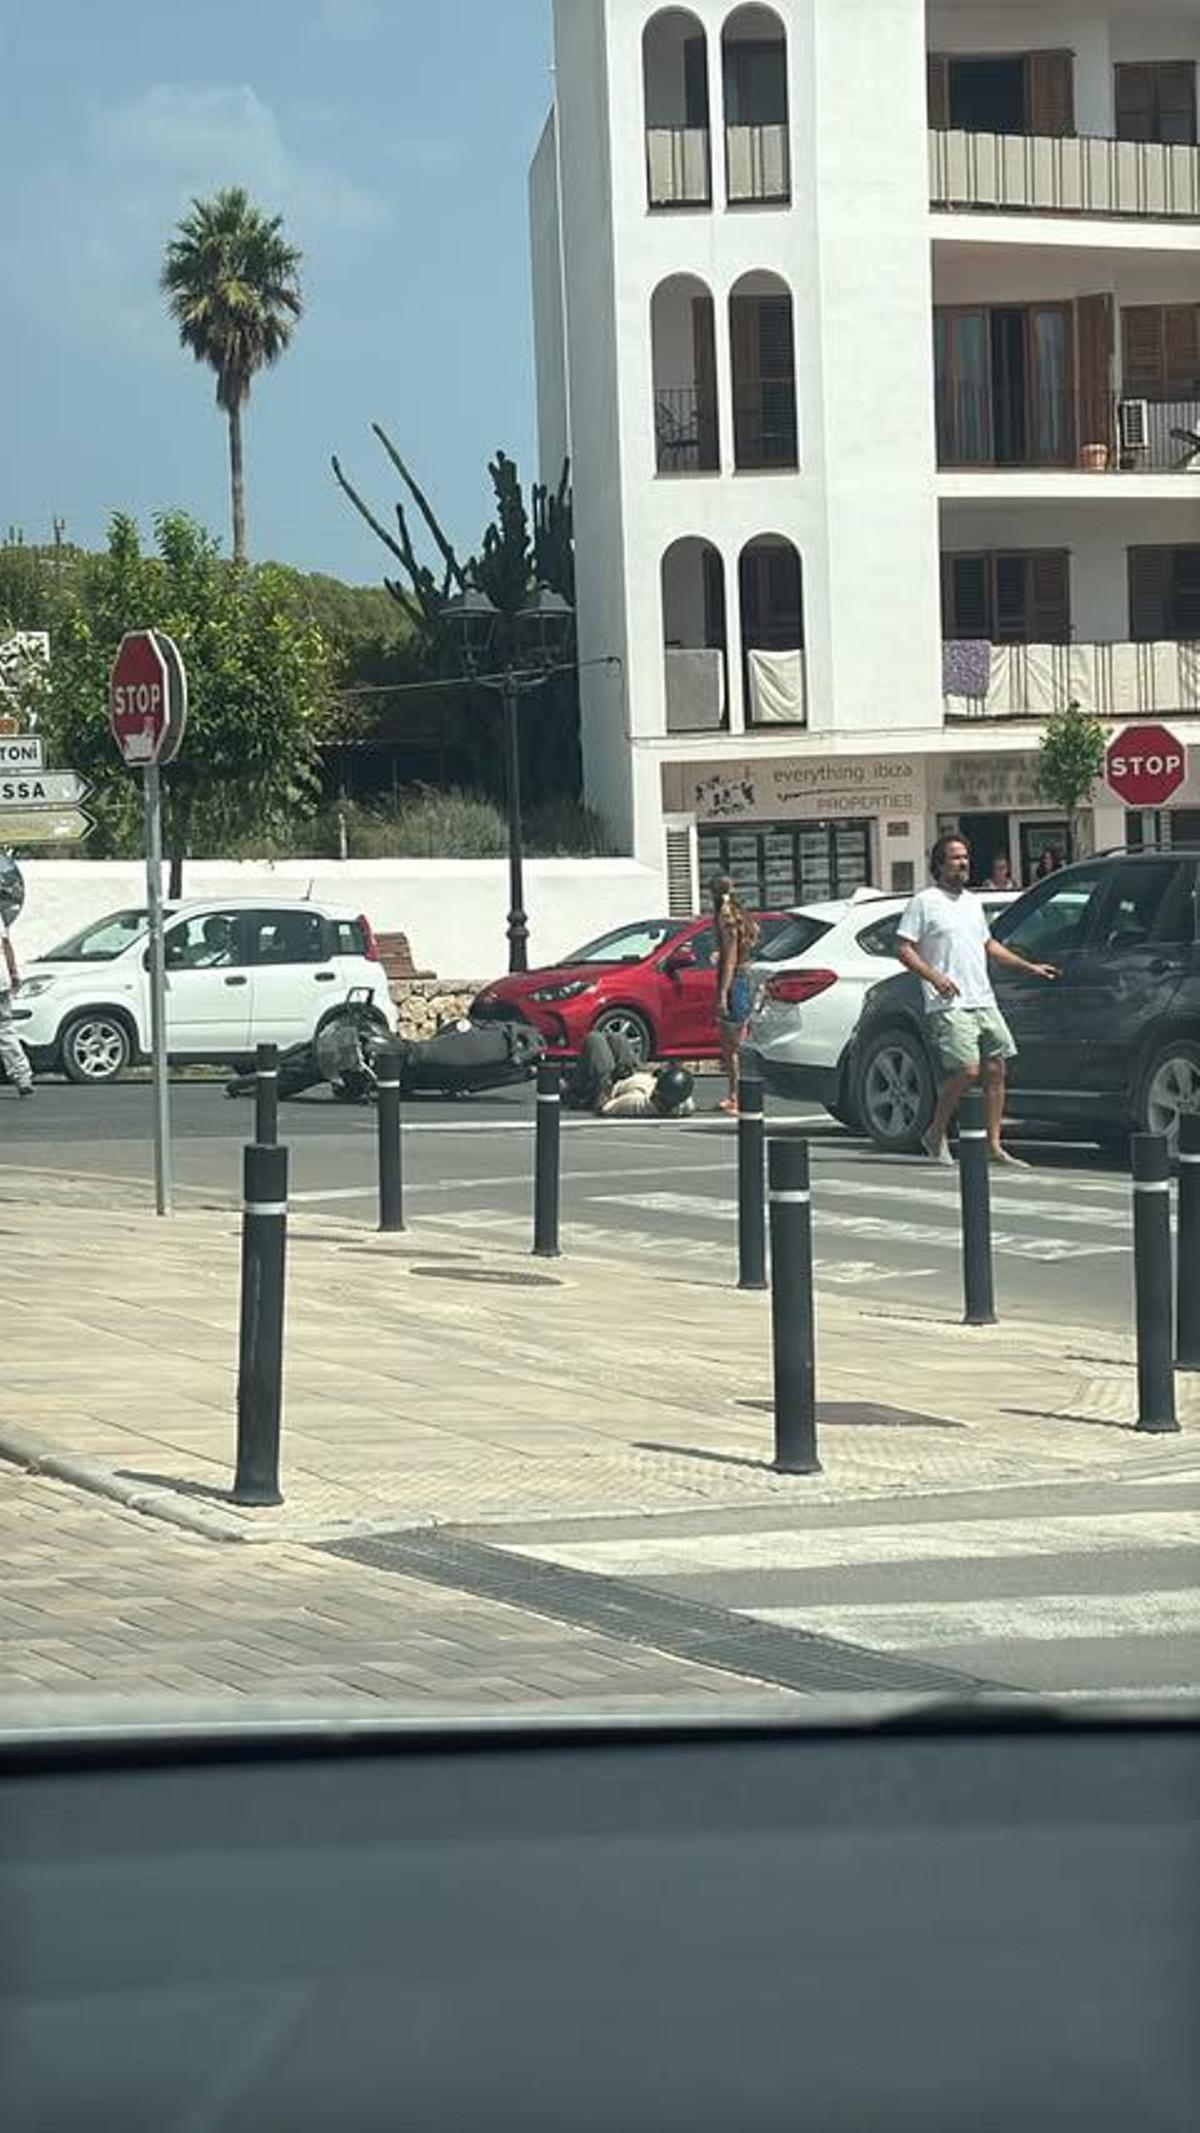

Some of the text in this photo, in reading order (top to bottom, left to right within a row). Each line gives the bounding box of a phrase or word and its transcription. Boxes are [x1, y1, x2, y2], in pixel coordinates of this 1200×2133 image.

[115, 684, 160, 714] STOP
[773, 763, 865, 785] everything
[1111, 755, 1181, 777] STOP
